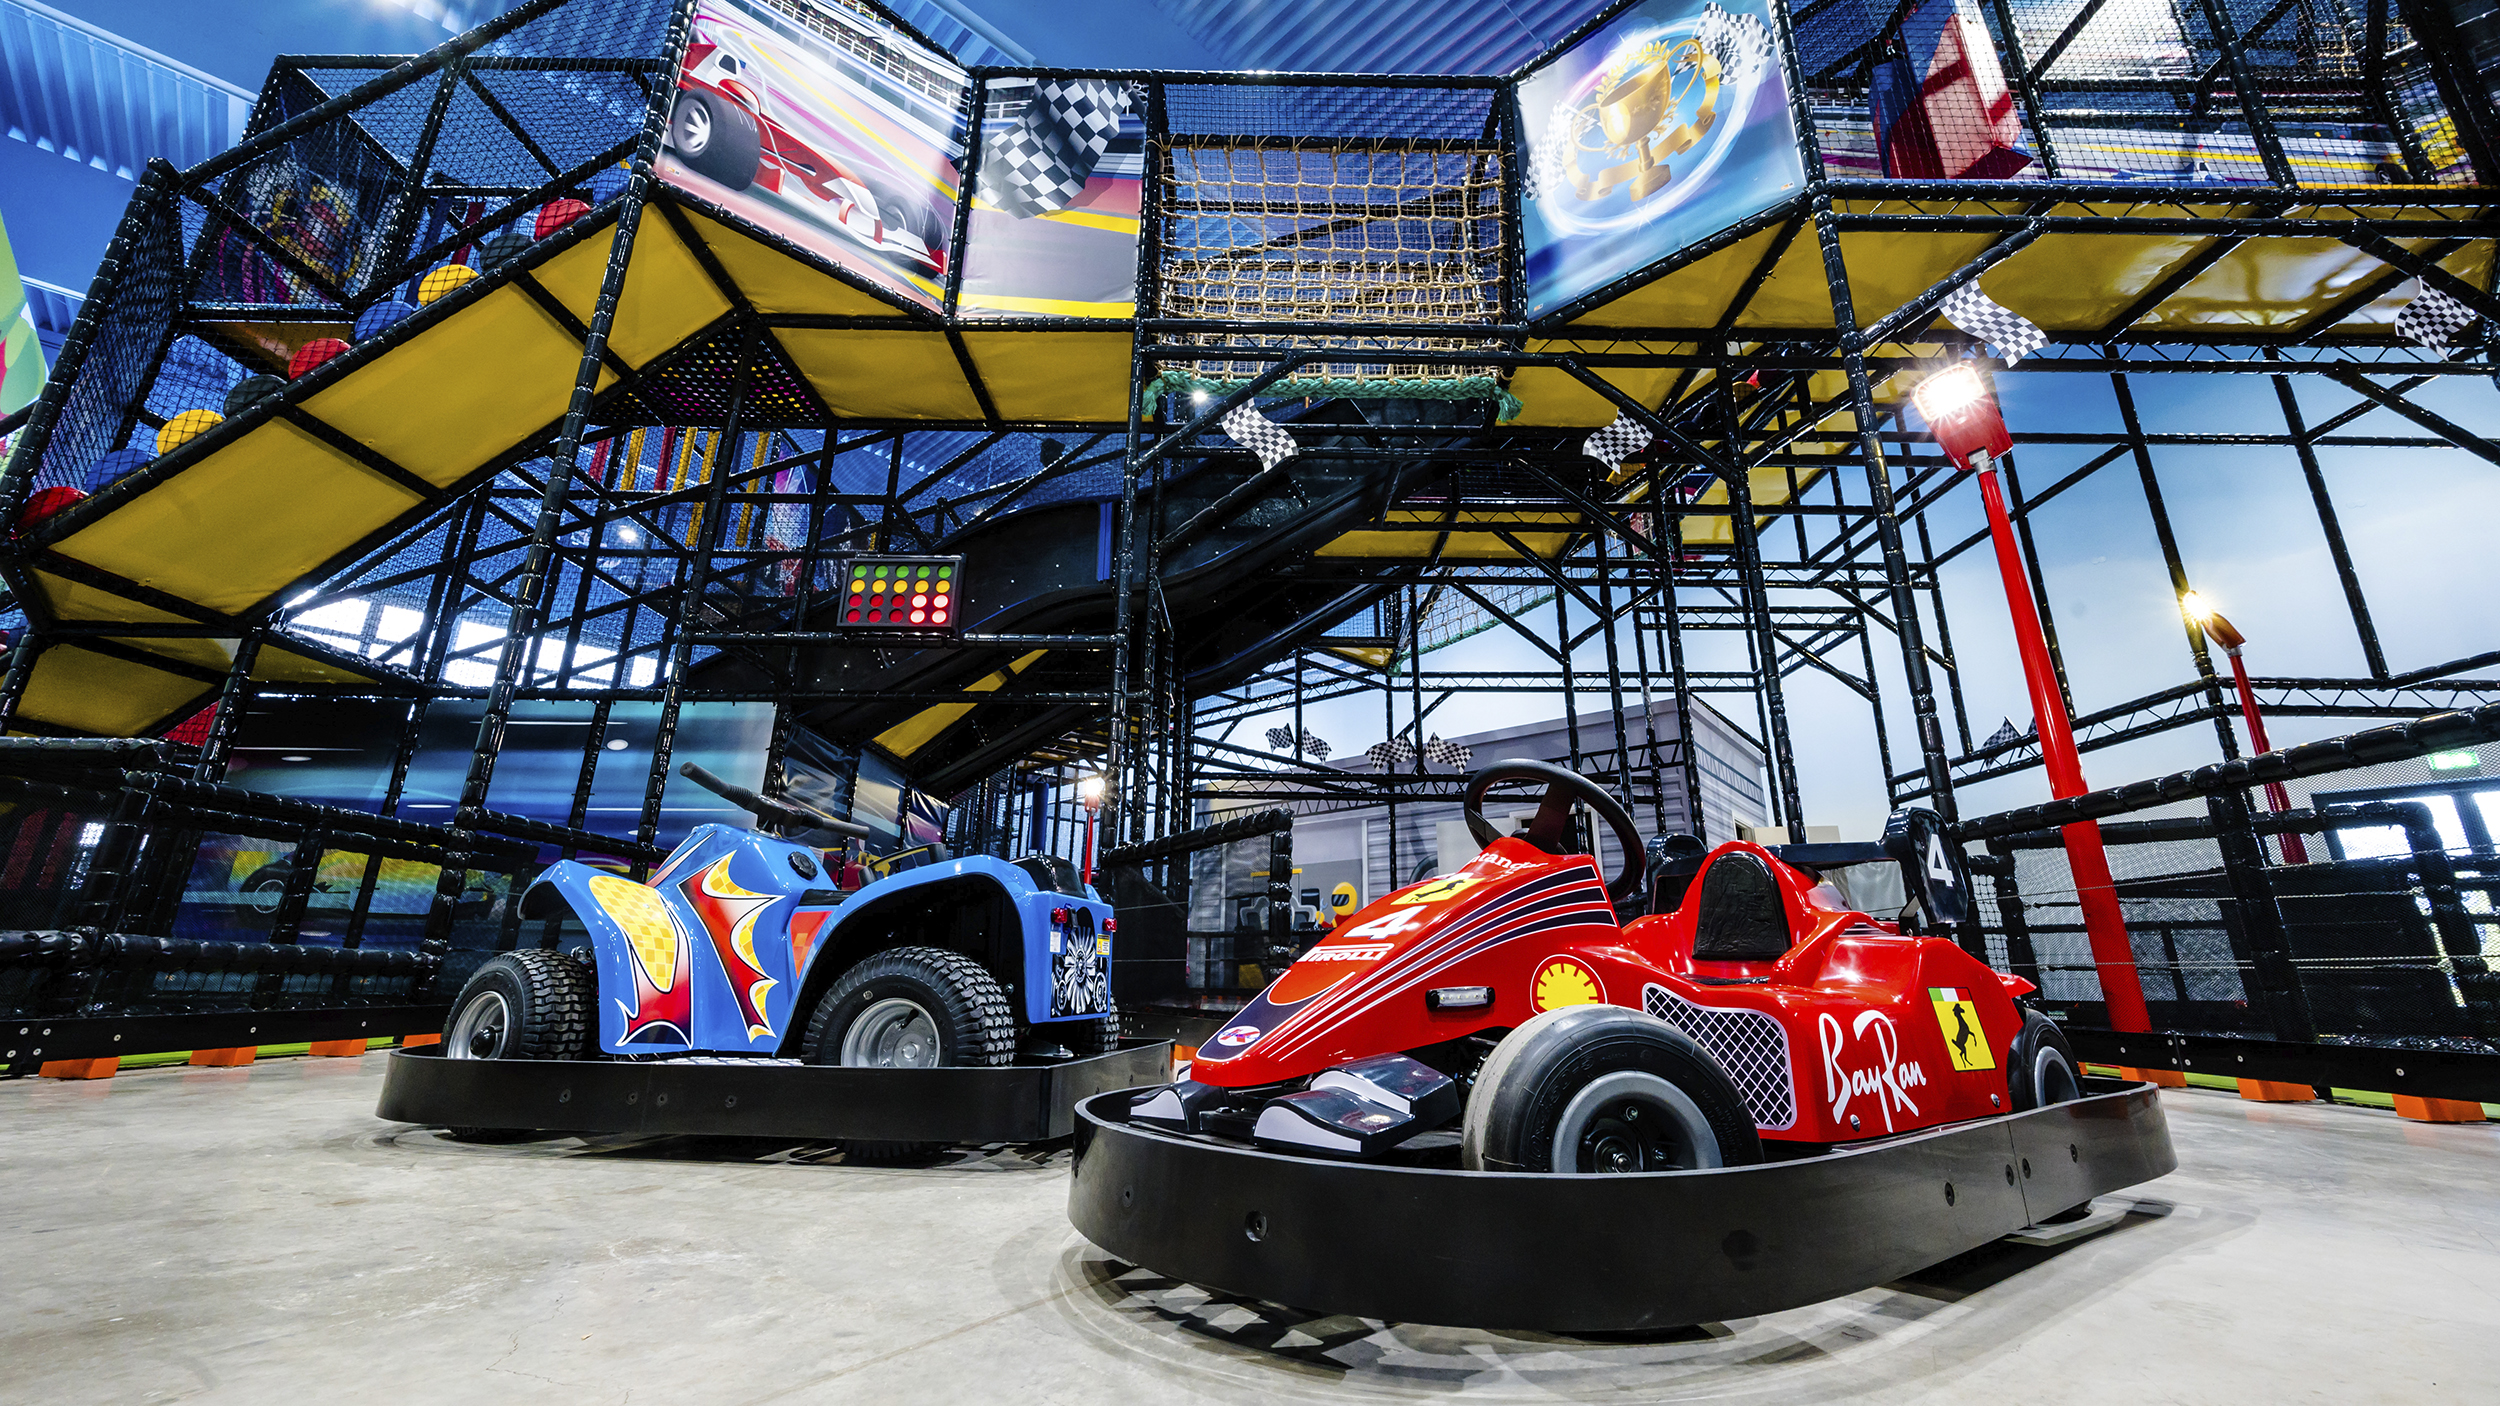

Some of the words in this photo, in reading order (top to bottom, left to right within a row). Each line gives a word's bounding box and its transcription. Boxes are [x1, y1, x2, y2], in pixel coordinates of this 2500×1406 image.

[1927, 833, 1955, 888] 4
[1341, 904, 1429, 940] 4
[1818, 1009, 1927, 1133] BayRan
